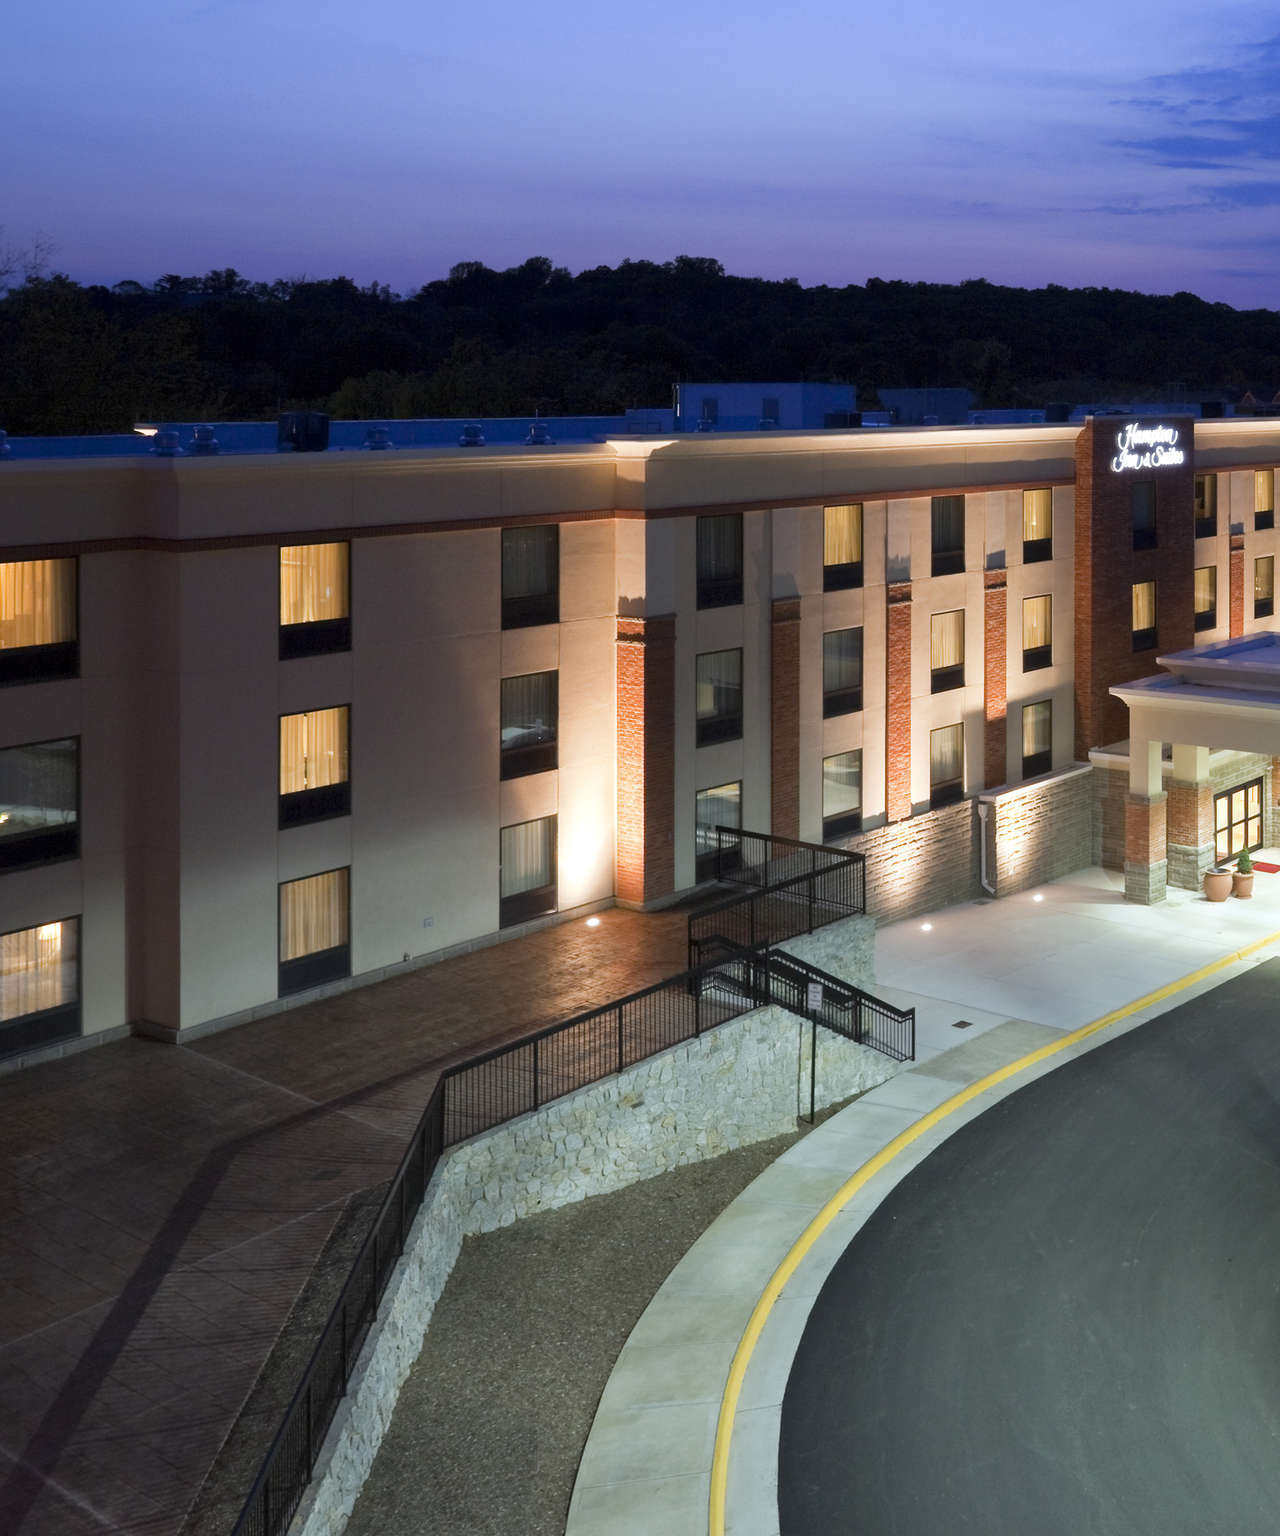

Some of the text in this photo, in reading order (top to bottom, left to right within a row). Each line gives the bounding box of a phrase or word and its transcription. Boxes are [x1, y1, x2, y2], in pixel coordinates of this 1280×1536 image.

[1118, 423, 1178, 449] Hampton
[1112, 446, 1184, 472] Inn & Suites
